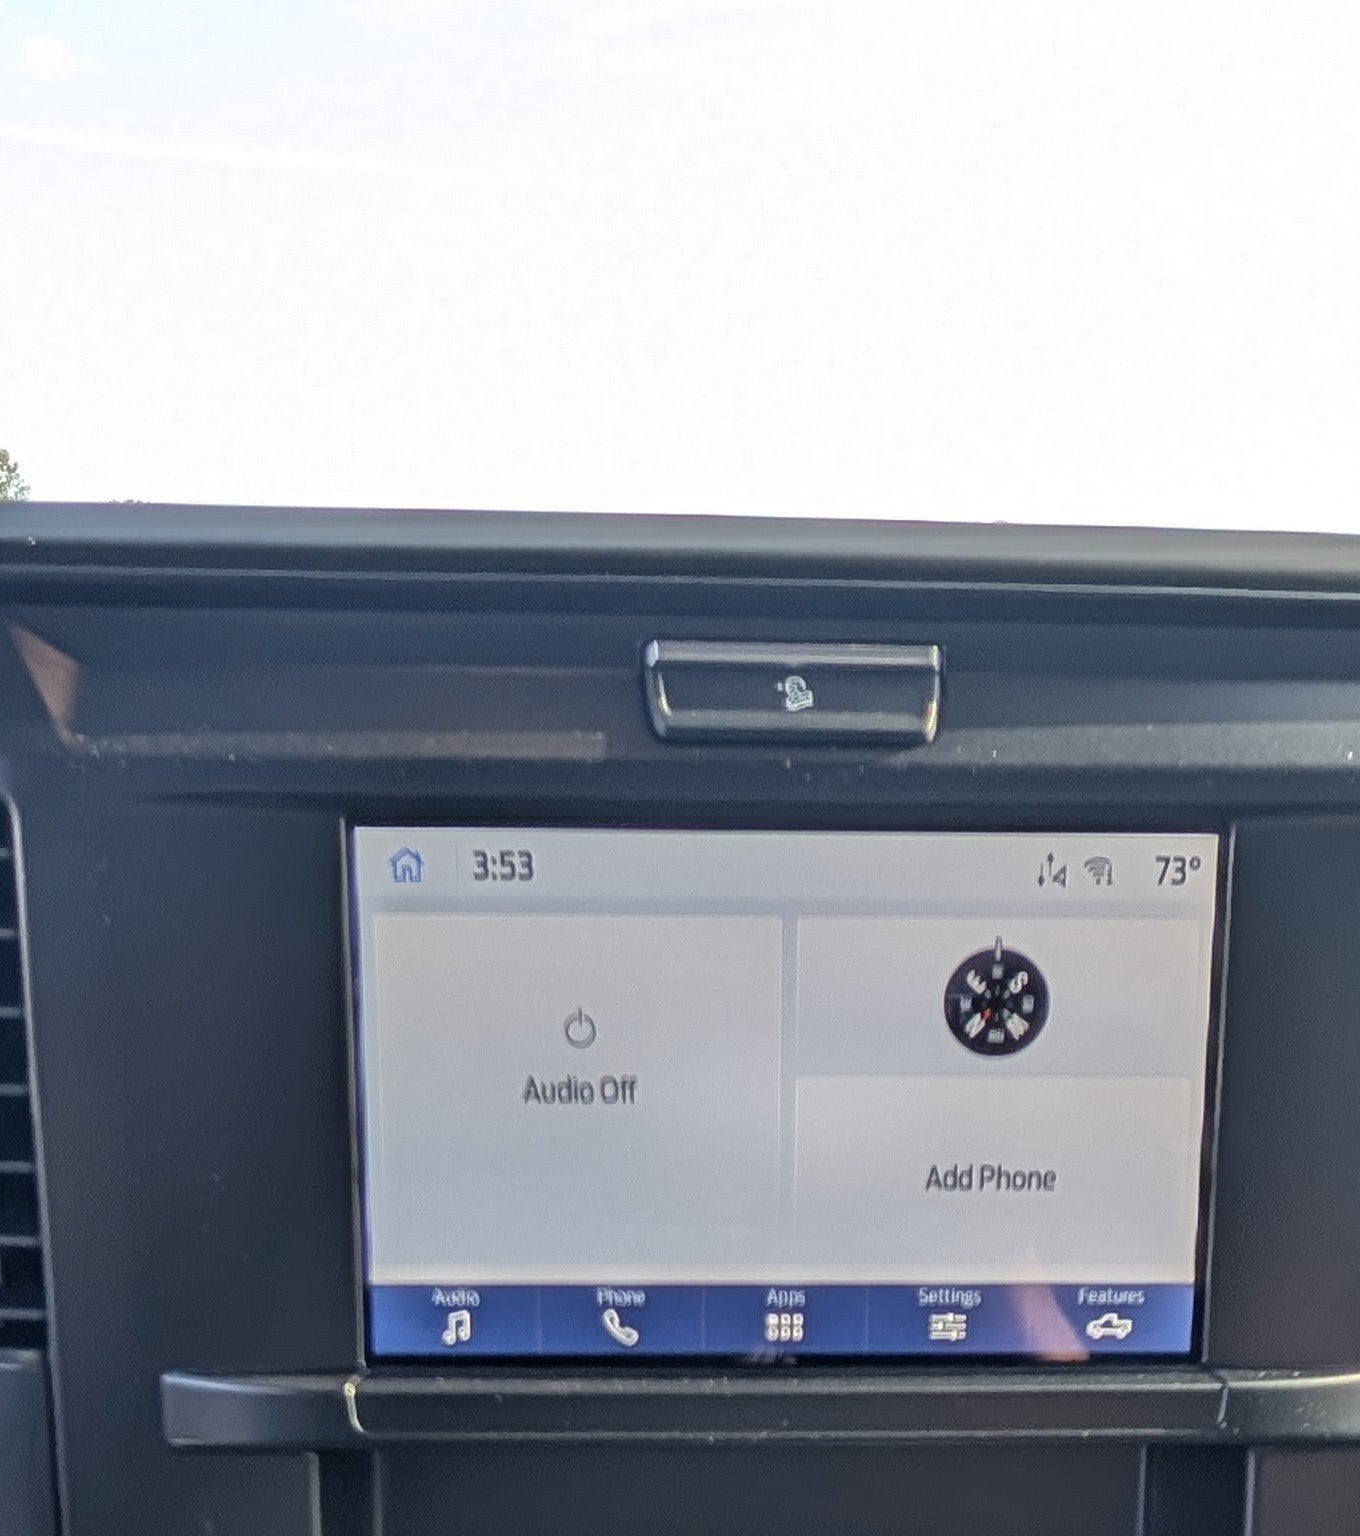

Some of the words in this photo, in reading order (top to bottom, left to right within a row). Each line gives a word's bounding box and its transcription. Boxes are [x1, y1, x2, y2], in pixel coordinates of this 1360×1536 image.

[473, 849, 534, 881] 3:53
[523, 1073, 595, 1105] Audio
[599, 1073, 638, 1105] Off
[925, 1163, 973, 1192] Add
[978, 1163, 1057, 1192] Phone
[431, 1286, 480, 1308] Audio
[596, 1286, 645, 1308] Phone
[766, 1286, 806, 1308] Apps
[918, 1286, 981, 1309] Settings
[1078, 1286, 1145, 1307] Features
